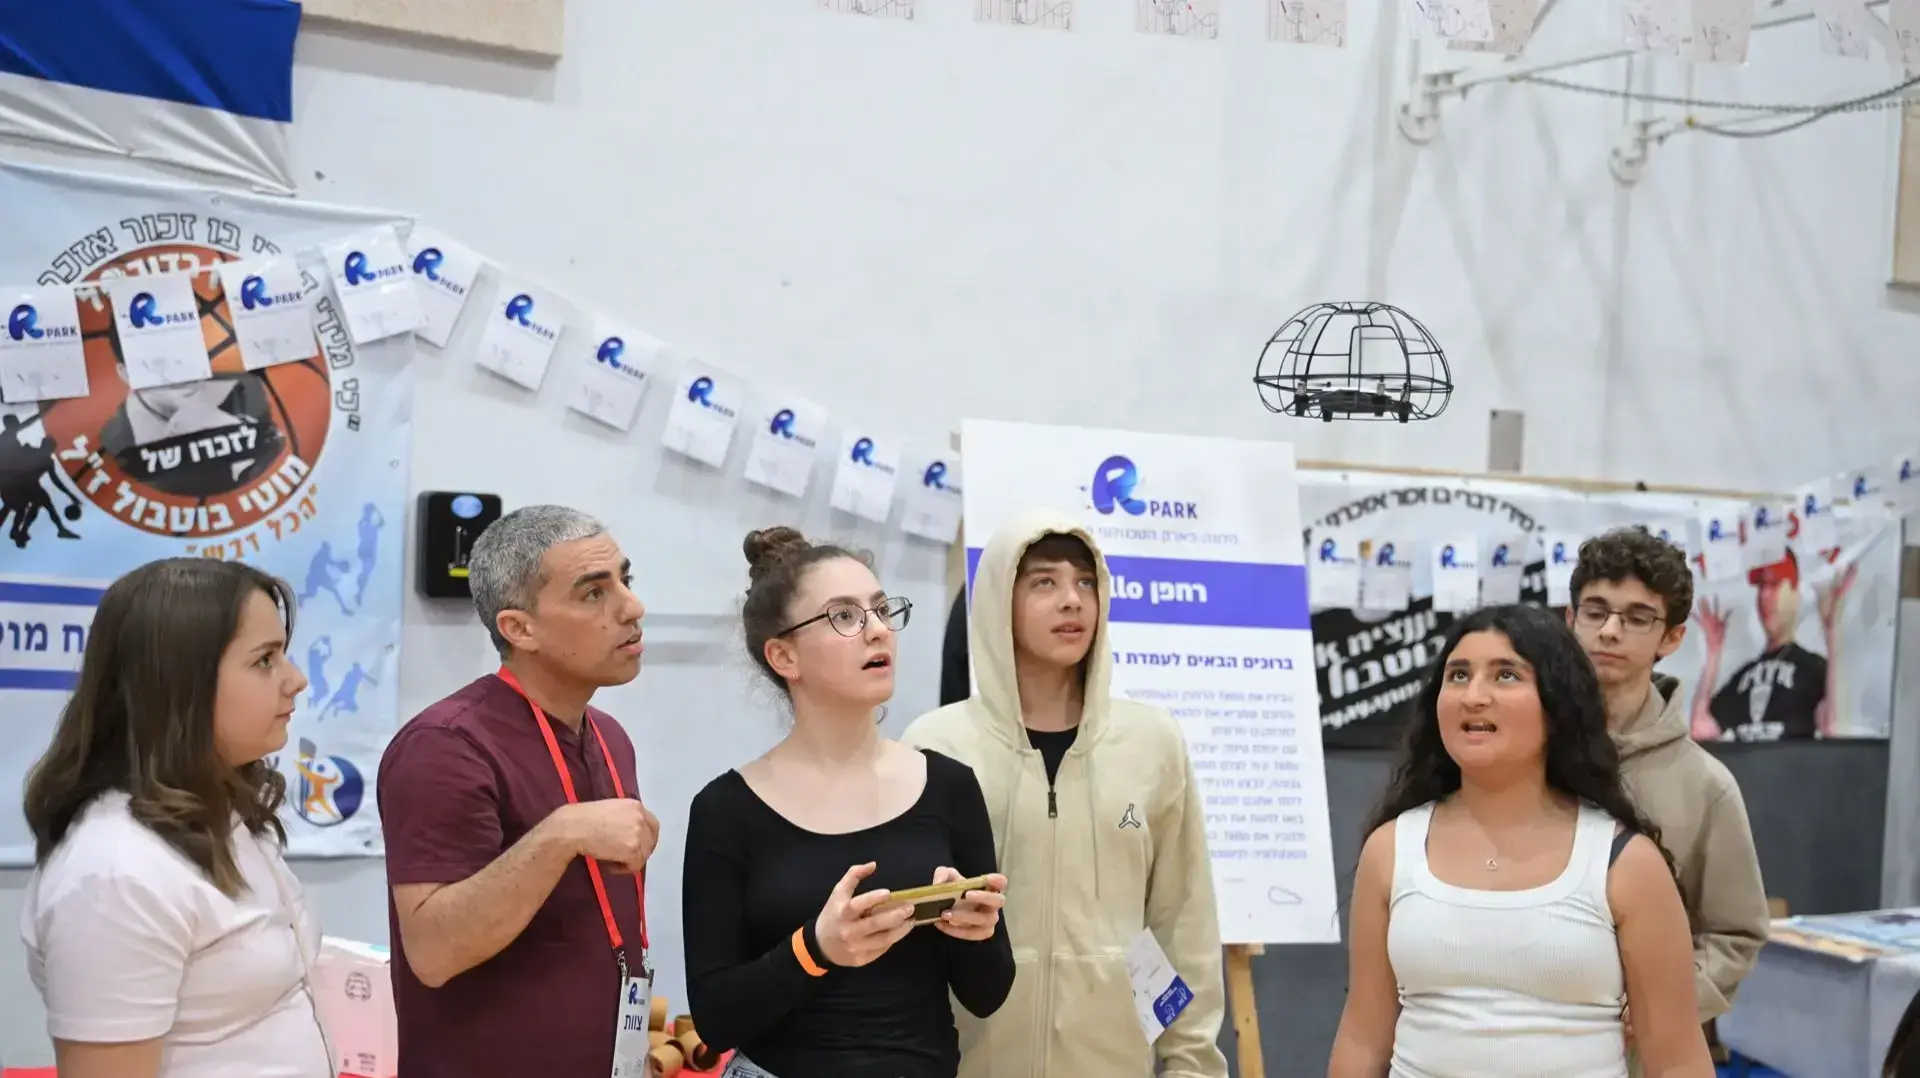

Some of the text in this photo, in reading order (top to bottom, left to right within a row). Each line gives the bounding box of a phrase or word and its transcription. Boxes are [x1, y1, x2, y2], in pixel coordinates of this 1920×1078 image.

[119, 212, 198, 244] זכור
[206, 217, 242, 252] בו
[166, 311, 197, 325] PARK
[46, 325, 78, 339] PARK
[140, 426, 258, 473] לזכרו של
[239, 454, 311, 513] מוטי
[111, 481, 235, 534] בוטבול
[1149, 501, 1199, 520] PARK
[1150, 580, 1208, 605] רחפן
[1125, 650, 1181, 667] לעמדת
[1187, 653, 1238, 669] הבאים
[1243, 654, 1294, 671] ברוכים
[623, 1014, 643, 1031] צוות
